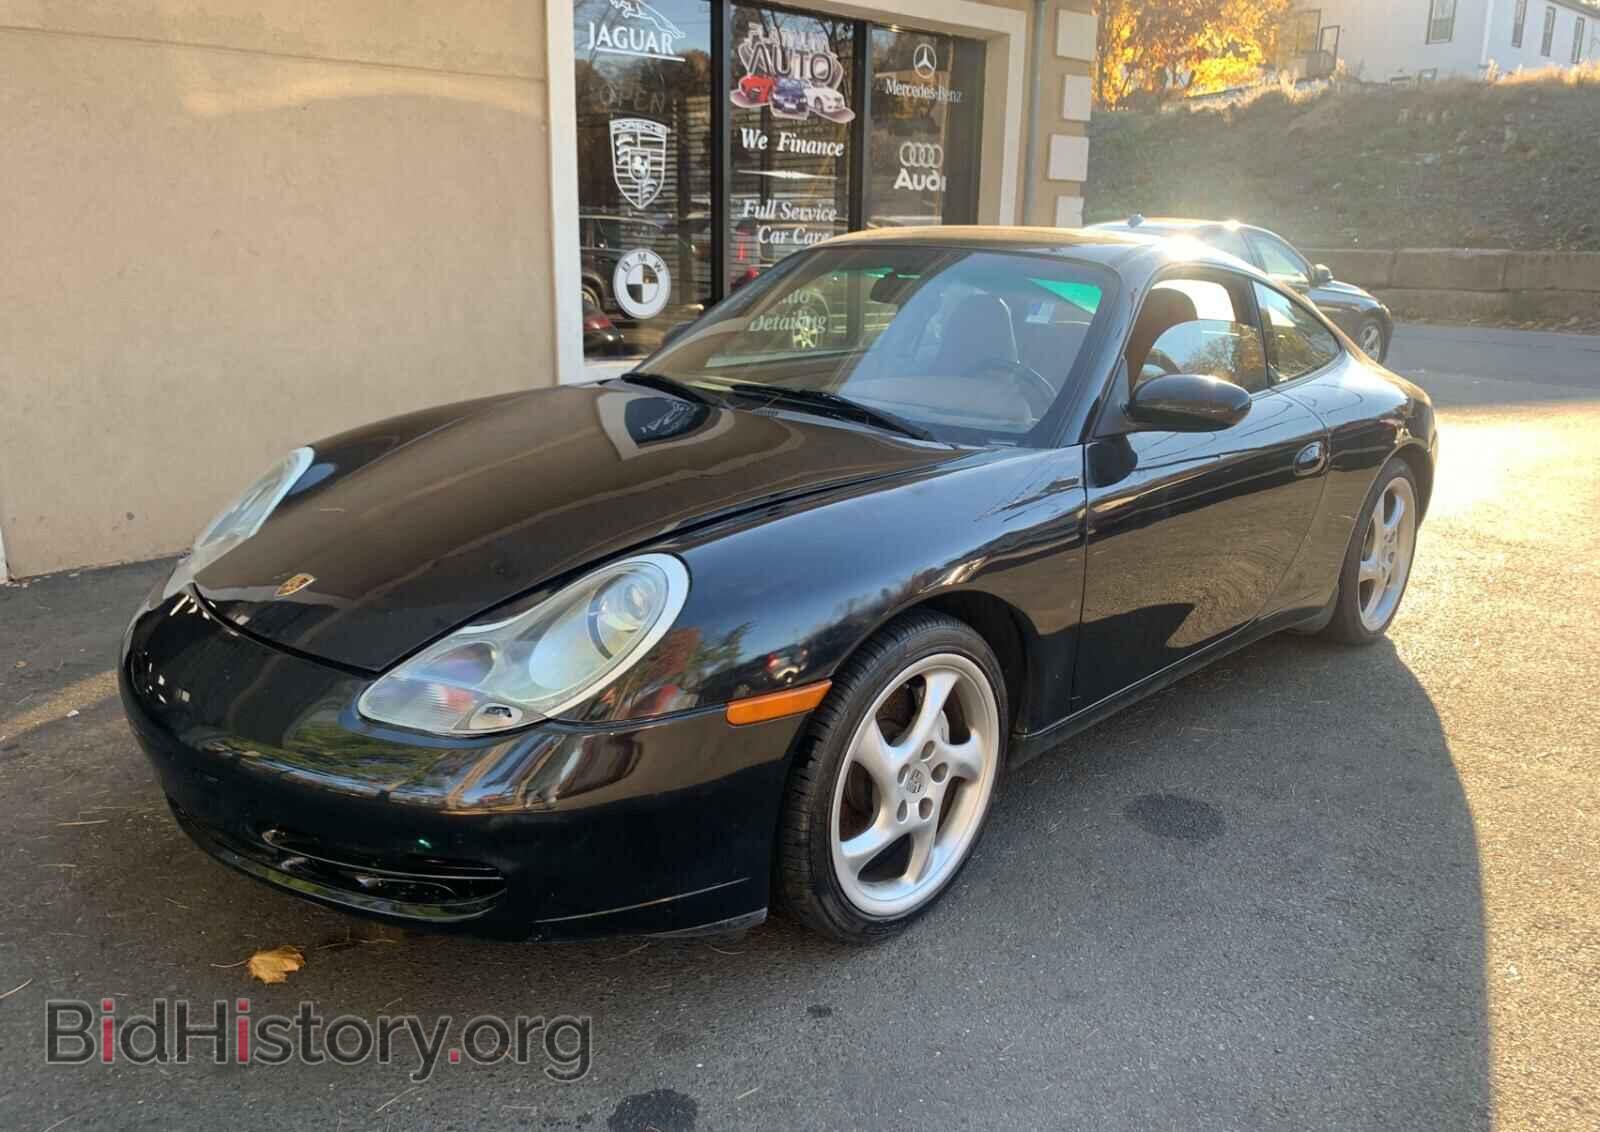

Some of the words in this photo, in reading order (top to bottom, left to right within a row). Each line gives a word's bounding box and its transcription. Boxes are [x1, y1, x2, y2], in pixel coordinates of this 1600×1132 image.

[587, 22, 675, 55] JAGUAR
[748, 43, 833, 84] AUTO
[885, 78, 963, 104] Mercedes-Benz
[741, 128, 768, 150] We
[776, 132, 845, 157] Finance
[893, 168, 947, 192] Audi
[742, 199, 777, 220] Full
[780, 201, 838, 222] Service
[757, 224, 789, 245] Car
[621, 252, 664, 273] BMW
